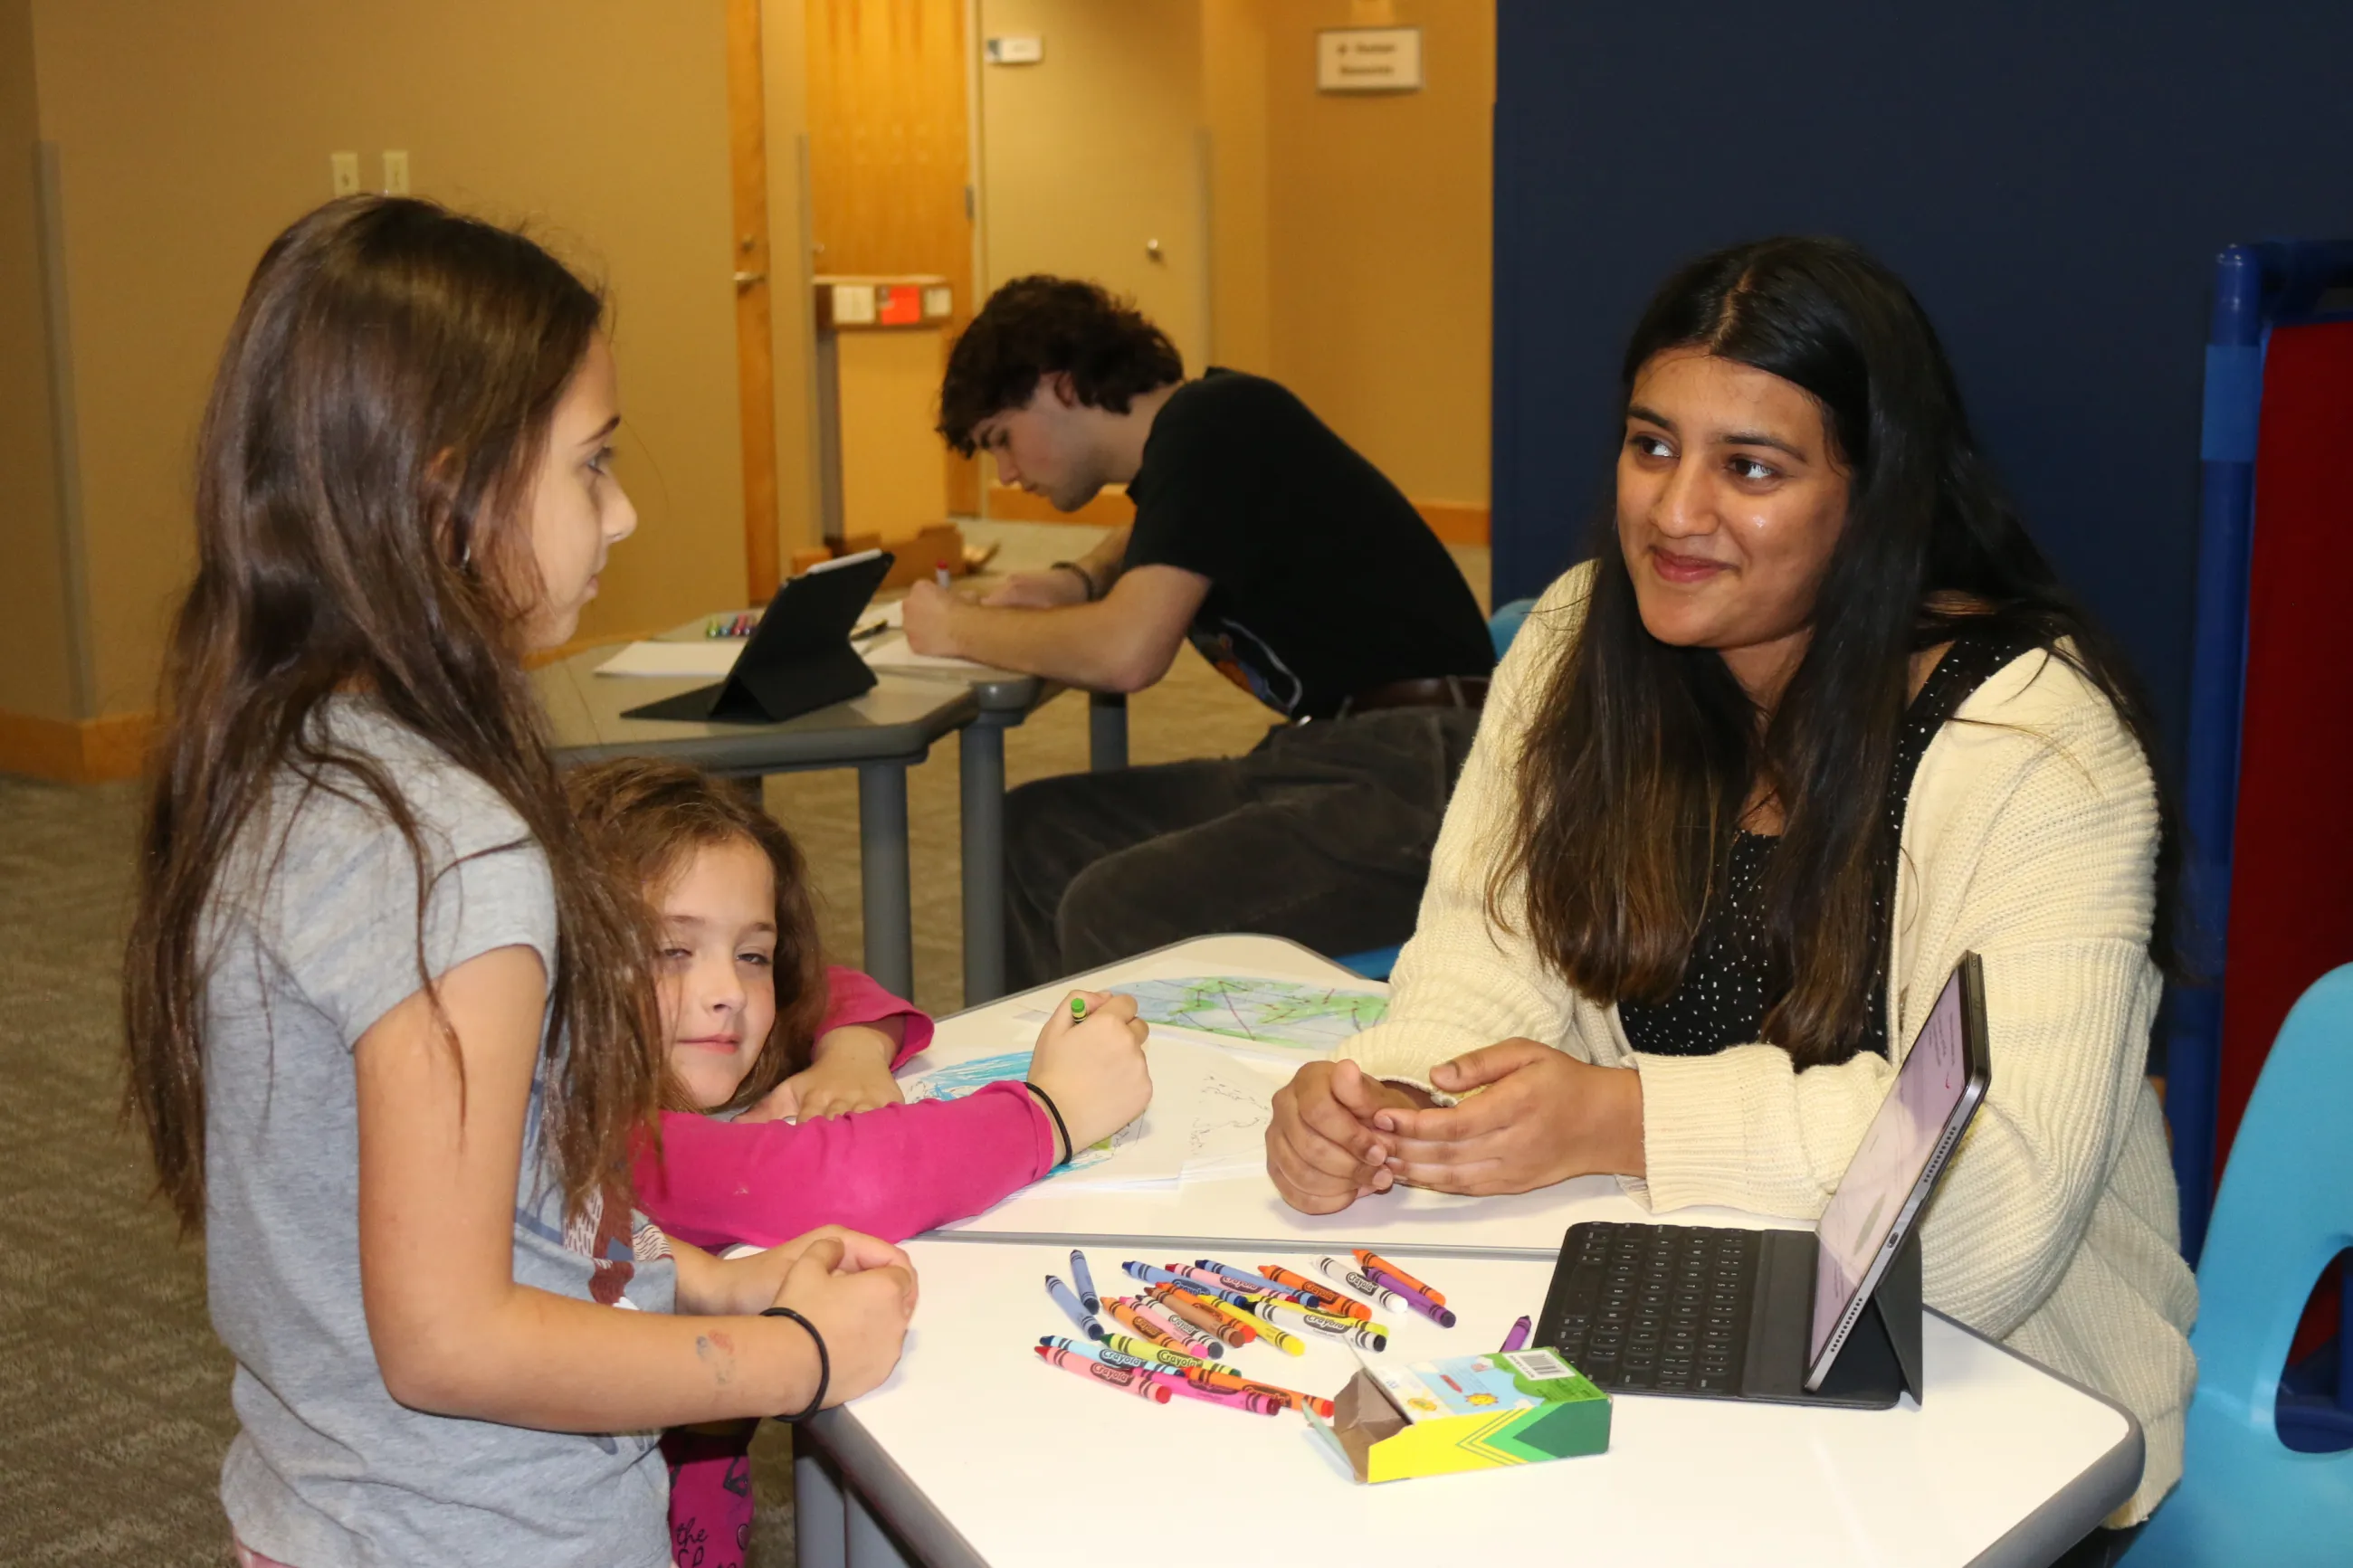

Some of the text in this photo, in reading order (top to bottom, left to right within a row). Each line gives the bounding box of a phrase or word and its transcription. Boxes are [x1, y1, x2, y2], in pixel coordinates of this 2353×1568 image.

[1305, 1282, 1337, 1301] Crayola
[1348, 1273, 1375, 1293] Crayola
[1170, 1316, 1196, 1335] Crayola
[1102, 1348, 1141, 1368] Crayola
[1159, 1350, 1197, 1367] Crayola
[1093, 1363, 1130, 1383] Crayola
[674, 1516, 709, 1548] the
